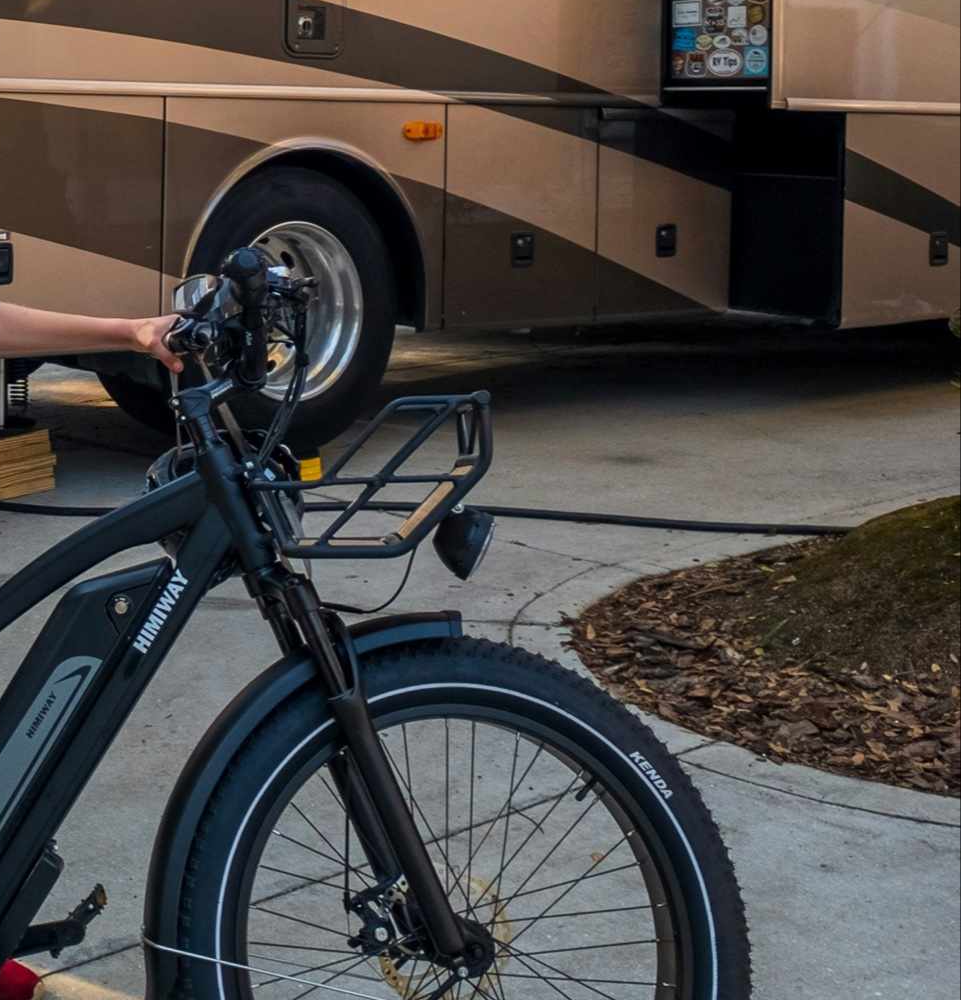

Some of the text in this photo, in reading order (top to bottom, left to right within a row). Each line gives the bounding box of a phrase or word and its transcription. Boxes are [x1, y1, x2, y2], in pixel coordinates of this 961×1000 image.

[132, 568, 189, 654] HIMIWAY
[25, 690, 56, 738] HIMIWAY
[629, 751, 673, 799] KENDA
